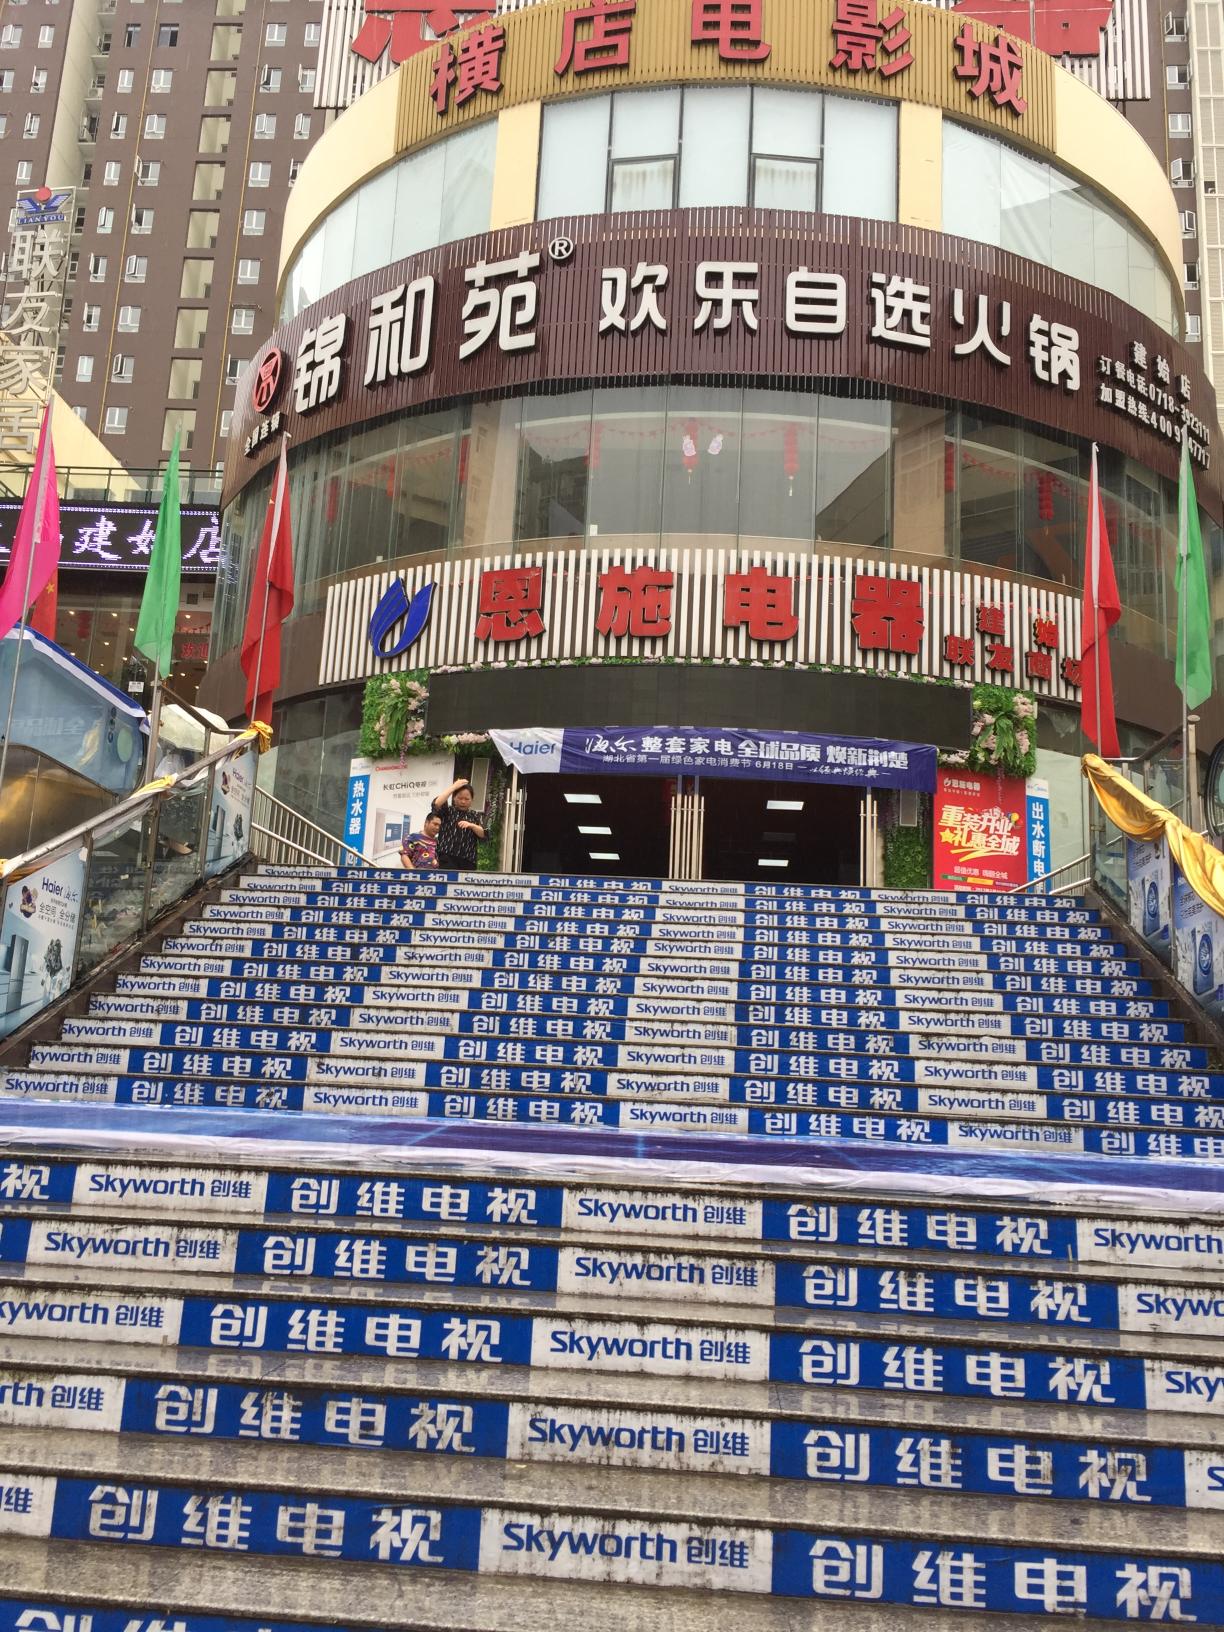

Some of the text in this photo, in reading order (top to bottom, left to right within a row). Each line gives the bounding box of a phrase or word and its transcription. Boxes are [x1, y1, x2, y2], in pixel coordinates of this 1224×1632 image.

[431, 0, 1029, 115] 横店电影城
[599, 261, 1081, 391] 欢乐自选火锅
[1133, 341, 1191, 400] 建始店
[474, 565, 924, 655] 恩施电器
[509, 738, 556, 755] Haier
[349, 780, 365, 835] 热水器
[41, 876, 63, 897] Haier
[1166, 1371, 1224, 1402] Sky
